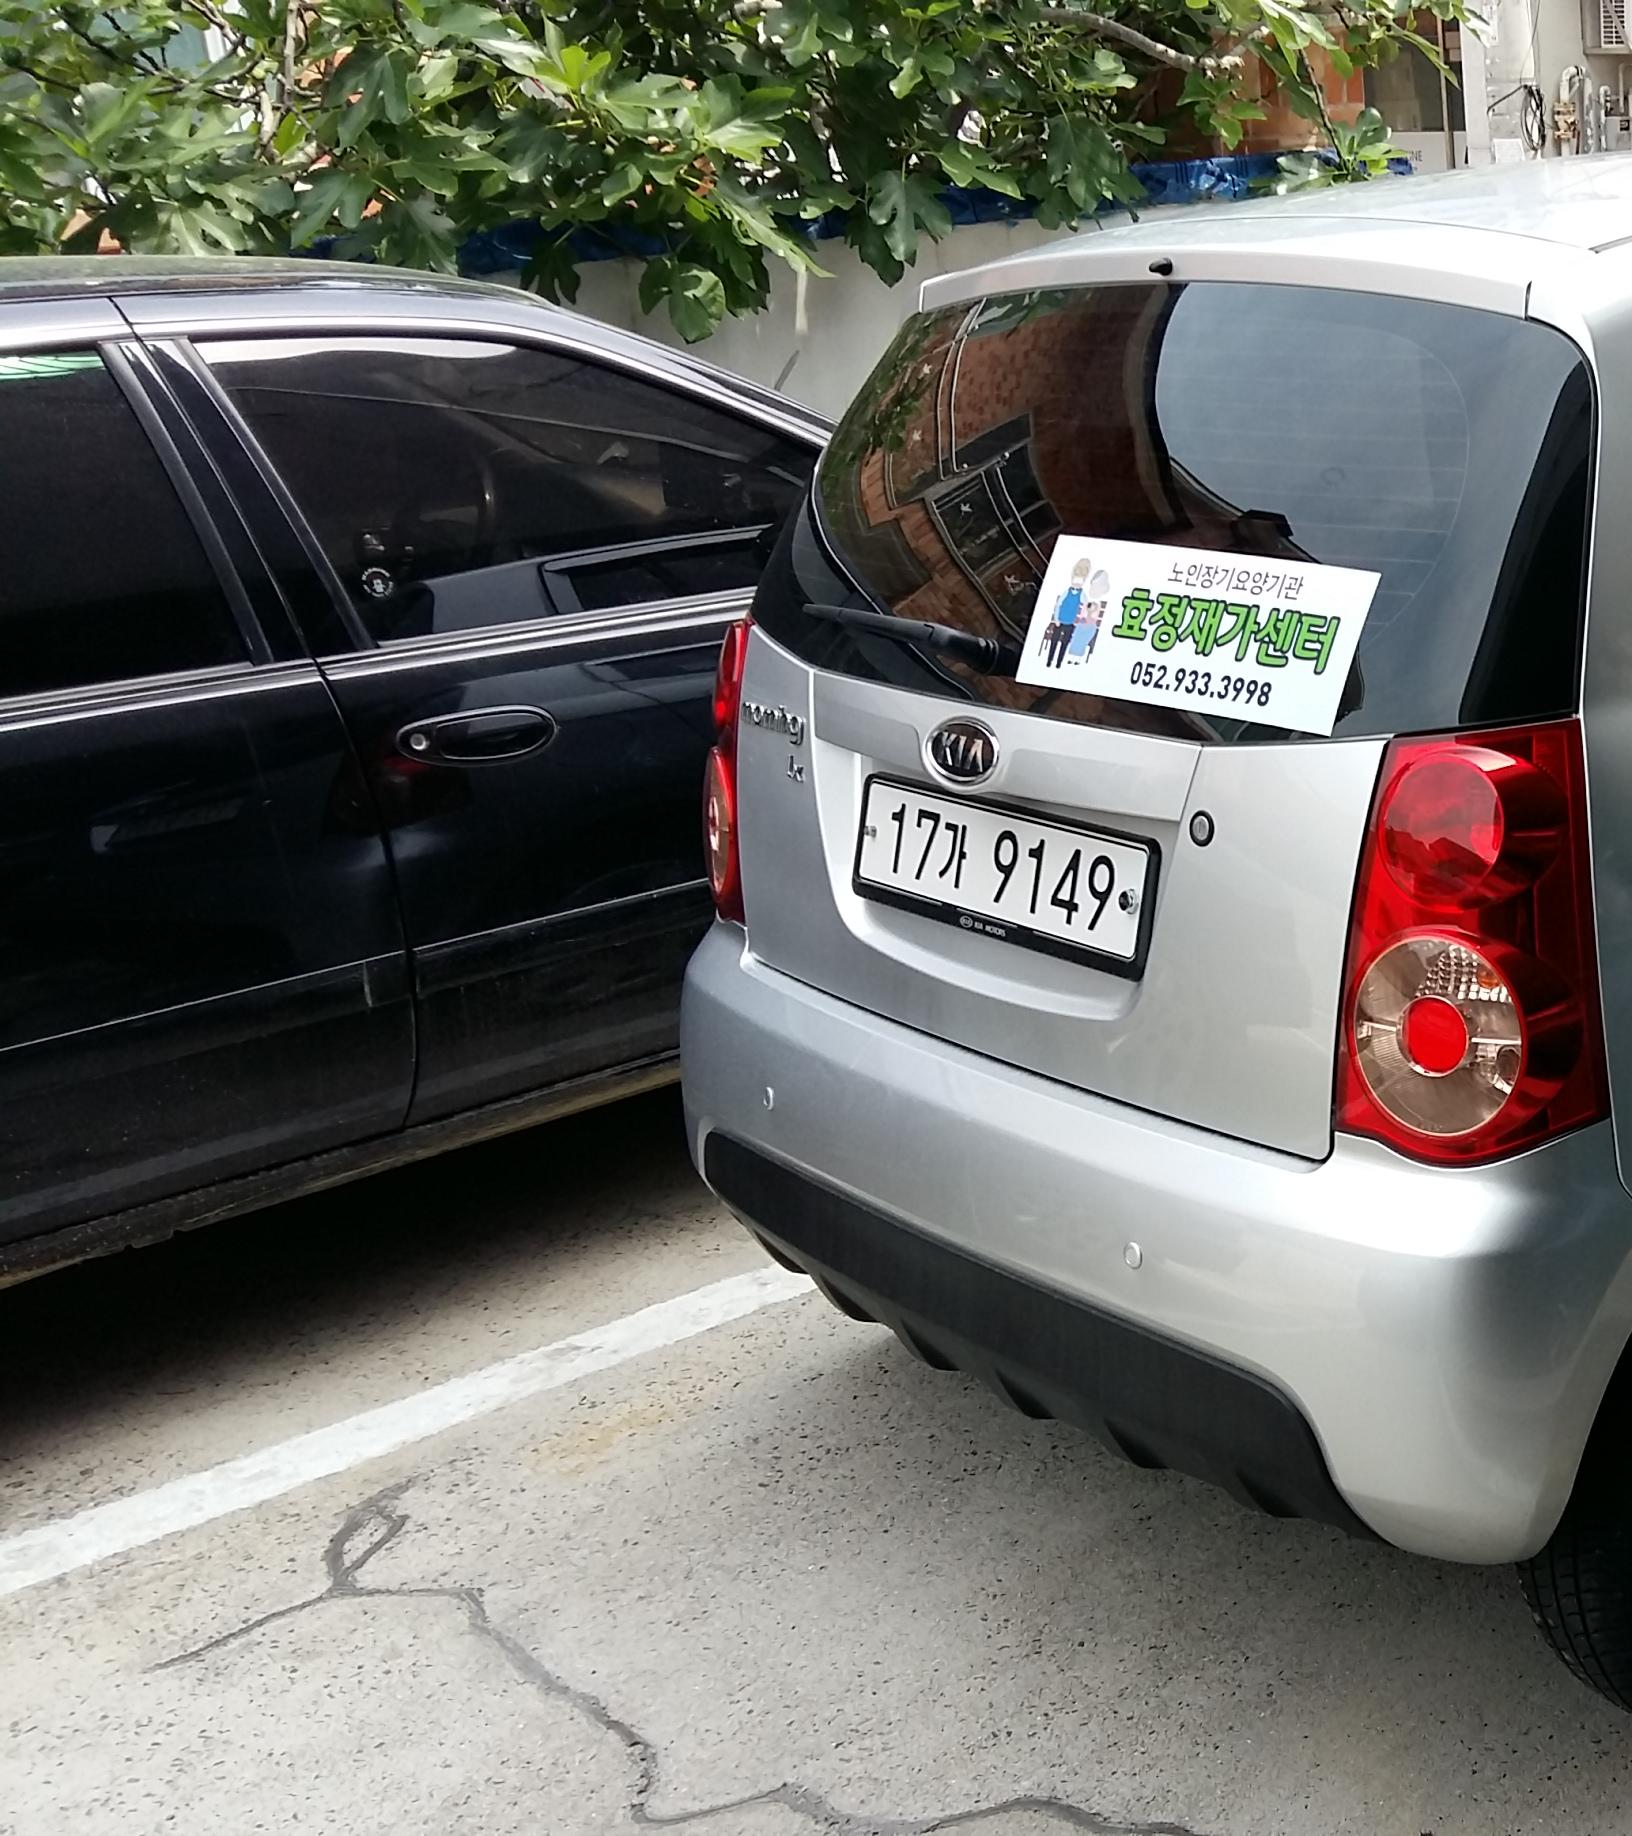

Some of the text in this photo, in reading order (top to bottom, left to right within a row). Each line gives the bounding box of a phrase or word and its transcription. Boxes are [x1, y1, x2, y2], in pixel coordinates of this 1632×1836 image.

[1168, 562, 1304, 601] 노인장기요양기관
[1112, 587, 1341, 675] 효정재가센터
[1130, 660, 1272, 707] 052.933.3998
[938, 731, 983, 774] KIA
[891, 803, 1117, 931] 17가 9149
